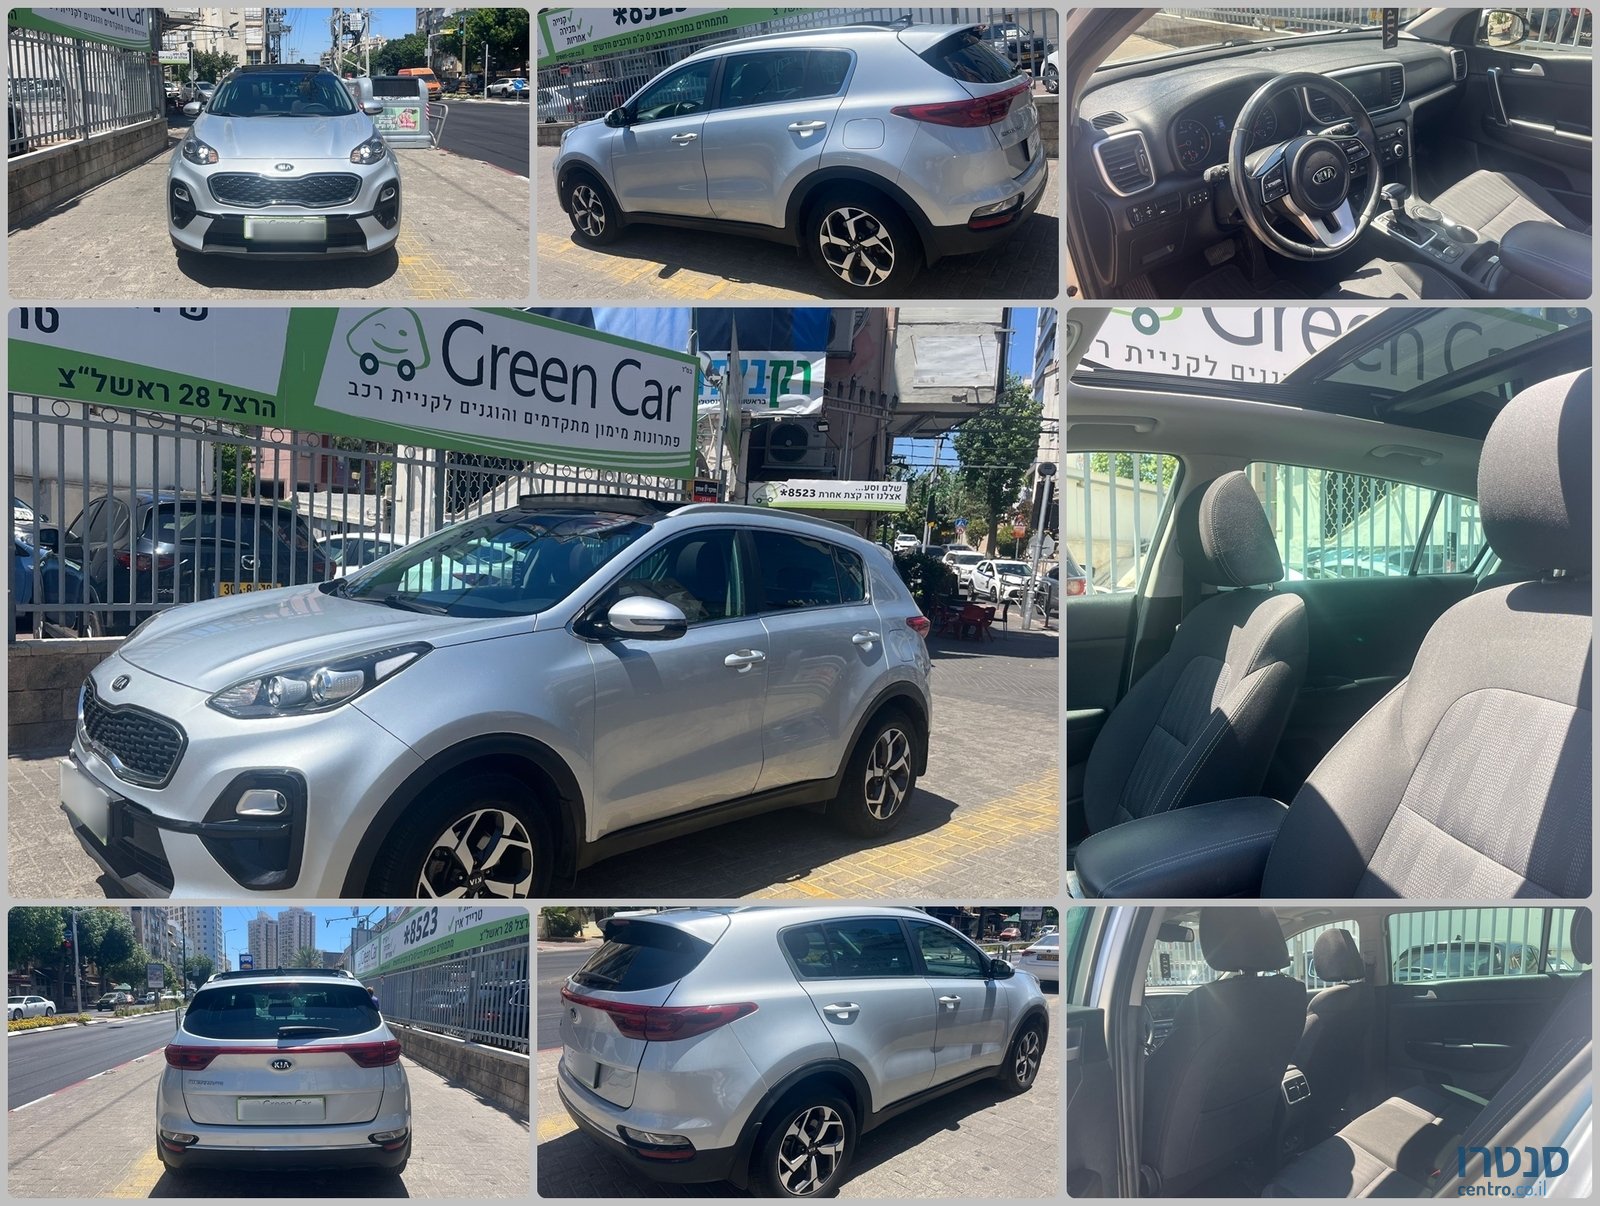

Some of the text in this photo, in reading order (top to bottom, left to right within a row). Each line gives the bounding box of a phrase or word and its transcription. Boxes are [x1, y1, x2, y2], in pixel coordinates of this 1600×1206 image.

[696, 15, 729, 30] מתמחים
[559, 24, 576, 36] מכירה
[652, 29, 666, 40] רכבי
[668, 22, 694, 37] במכירת
[566, 33, 587, 46] אחריות
[612, 37, 632, 48] ורכבים
[592, 41, 612, 52] חדשים
[1125, 344, 1217, 377] לקניית
[442, 318, 682, 423] Green Car
[179, 383, 210, 408] 28
[218, 388, 276, 418] הרצל
[348, 381, 680, 448] פתרונות מימון מתקדמים והוגנים לקניית רכב
[882, 483, 902, 492] שלם
[818, 491, 842, 499] אחרת
[843, 492, 862, 501] קצת
[876, 492, 901, 500] אצלנו
[465, 909, 483, 926] טרייד
[504, 921, 514, 933] 28
